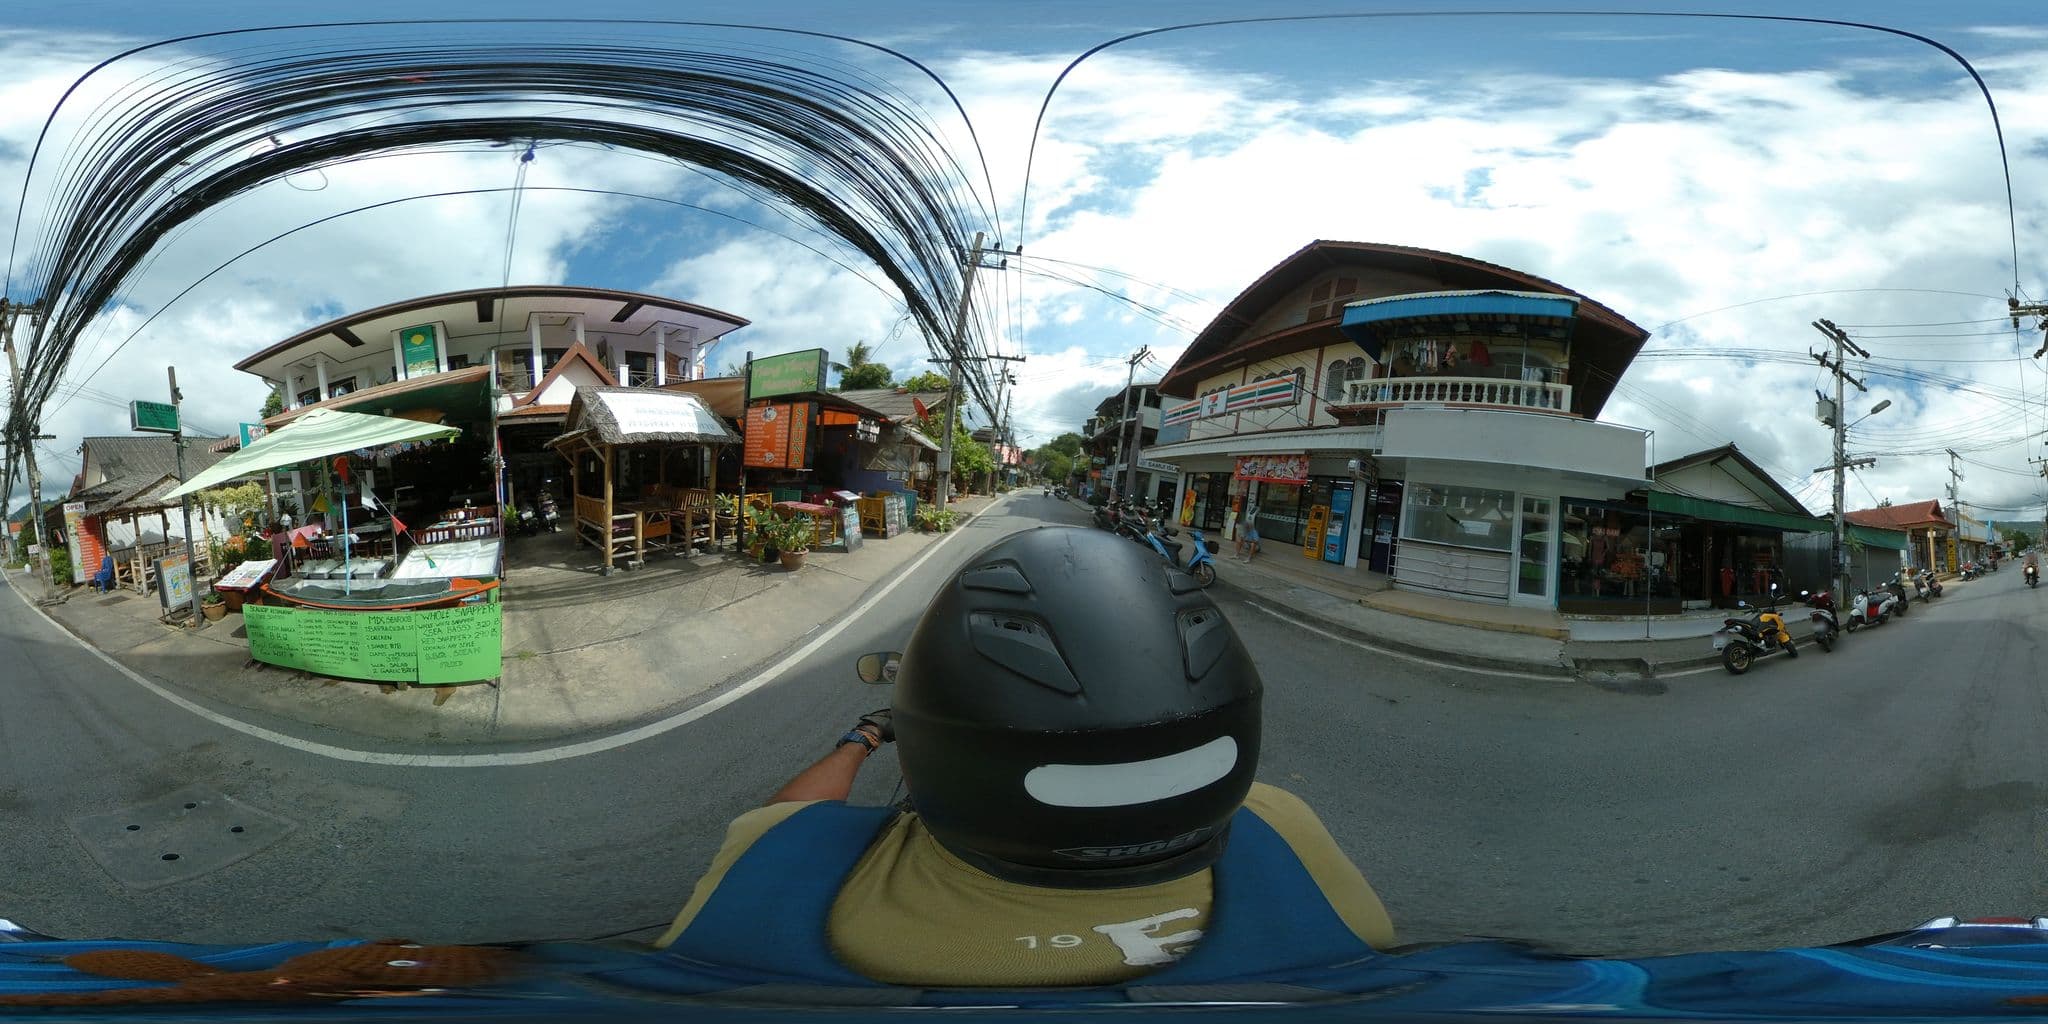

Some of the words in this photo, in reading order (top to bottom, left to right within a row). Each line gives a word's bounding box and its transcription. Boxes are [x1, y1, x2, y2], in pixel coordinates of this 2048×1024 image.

[791, 408, 805, 465] SAUNA
[66, 503, 84, 511] OPEN
[454, 603, 495, 617] SNAPPER
